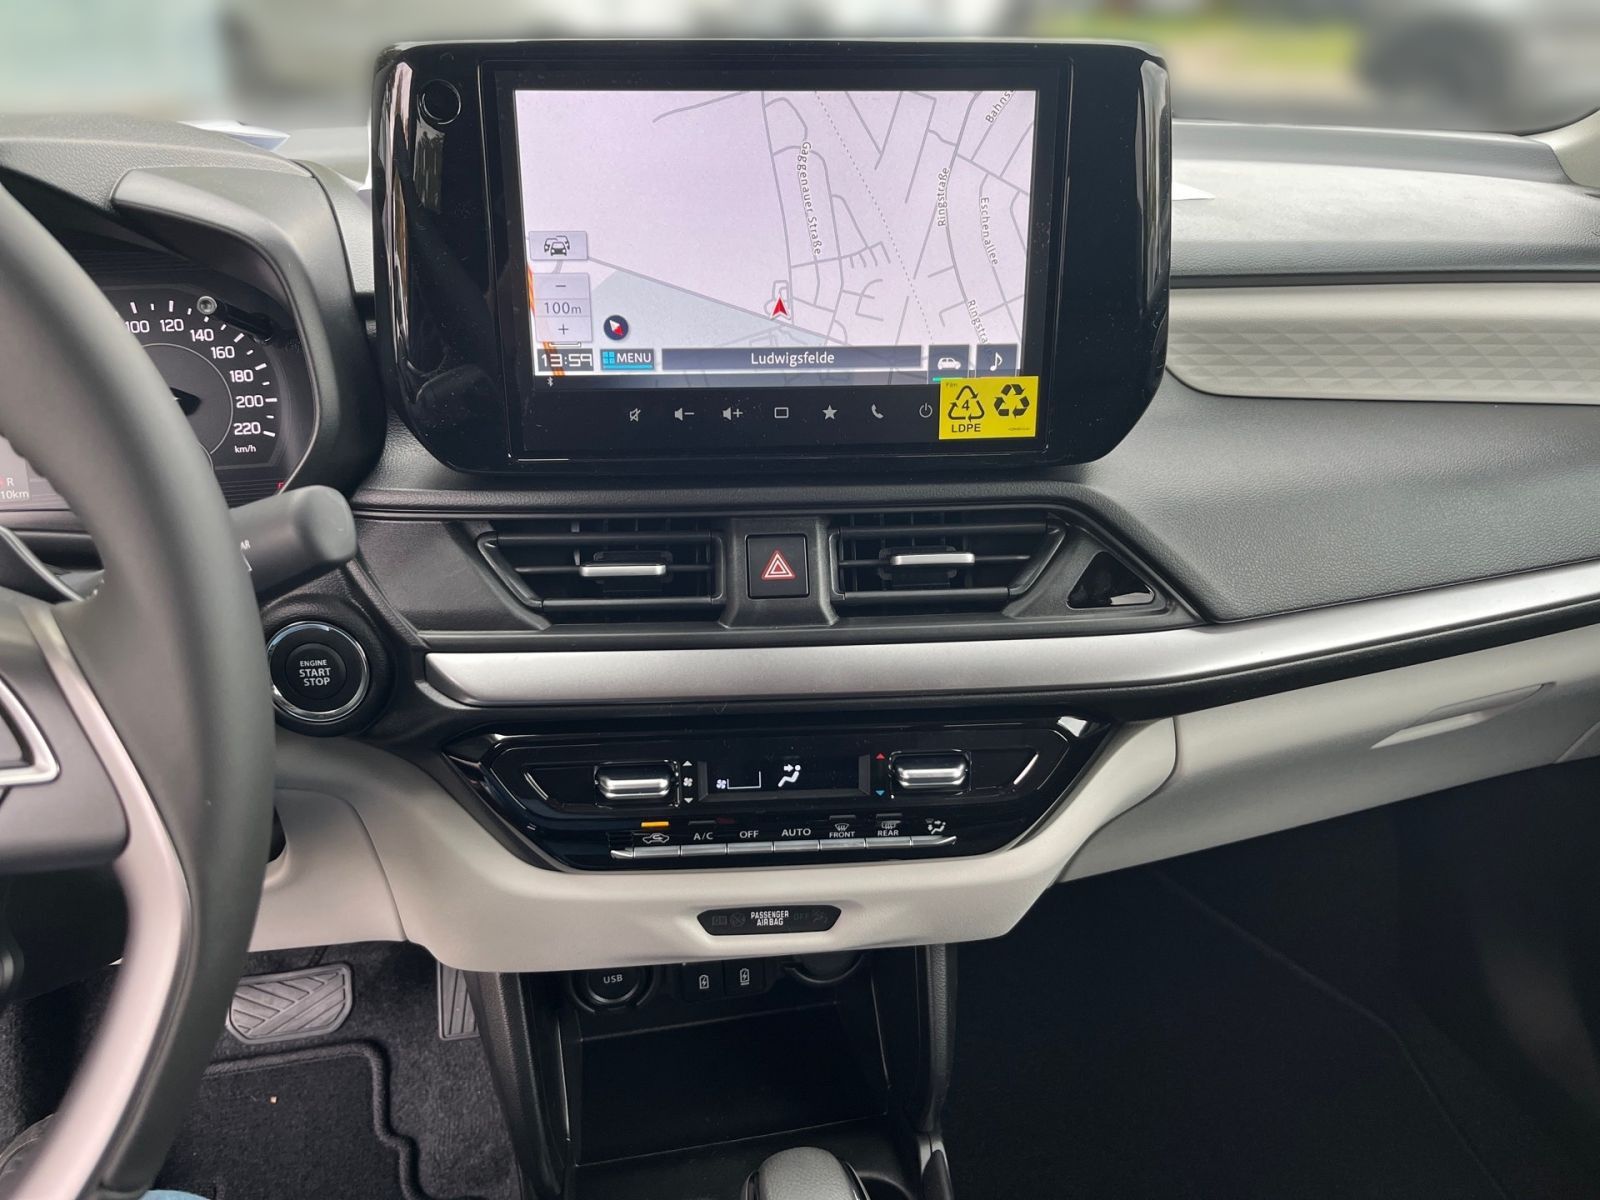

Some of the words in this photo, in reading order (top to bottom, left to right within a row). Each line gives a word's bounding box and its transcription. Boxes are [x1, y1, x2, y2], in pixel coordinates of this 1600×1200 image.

[985, 90, 1014, 122] Bahns
[797, 141, 813, 212] Gaggenauer
[808, 217, 822, 254] Straße
[937, 167, 949, 226] Ringstraße
[981, 197, 997, 265] Eschenallee
[544, 301, 581, 314] 100m
[125, 320, 150, 333] 100
[160, 318, 184, 332] 120
[189, 328, 214, 342] 140
[211, 345, 235, 359] 160
[616, 352, 652, 363] MENU
[541, 353, 593, 367] 13:59
[751, 351, 835, 367] Ludwigsfelde
[229, 369, 254, 382] 180
[235, 394, 264, 408] 200
[962, 399, 970, 410] 4
[233, 421, 261, 435] 220
[951, 423, 982, 433] LDPE
[234, 444, 257, 453] km/h
[6, 477, 14, 486] R
[299, 659, 327, 667] ENGINE
[299, 667, 331, 678] START
[303, 677, 331, 687] STOP
[693, 831, 714, 841] A/C
[739, 830, 760, 839] OFF
[781, 828, 812, 837] AUTO
[828, 830, 855, 838] FRONT
[877, 829, 899, 837] REAR
[750, 910, 790, 919] PASSENGER
[756, 917, 784, 927] AIRBAG
[603, 973, 623, 984] USB
